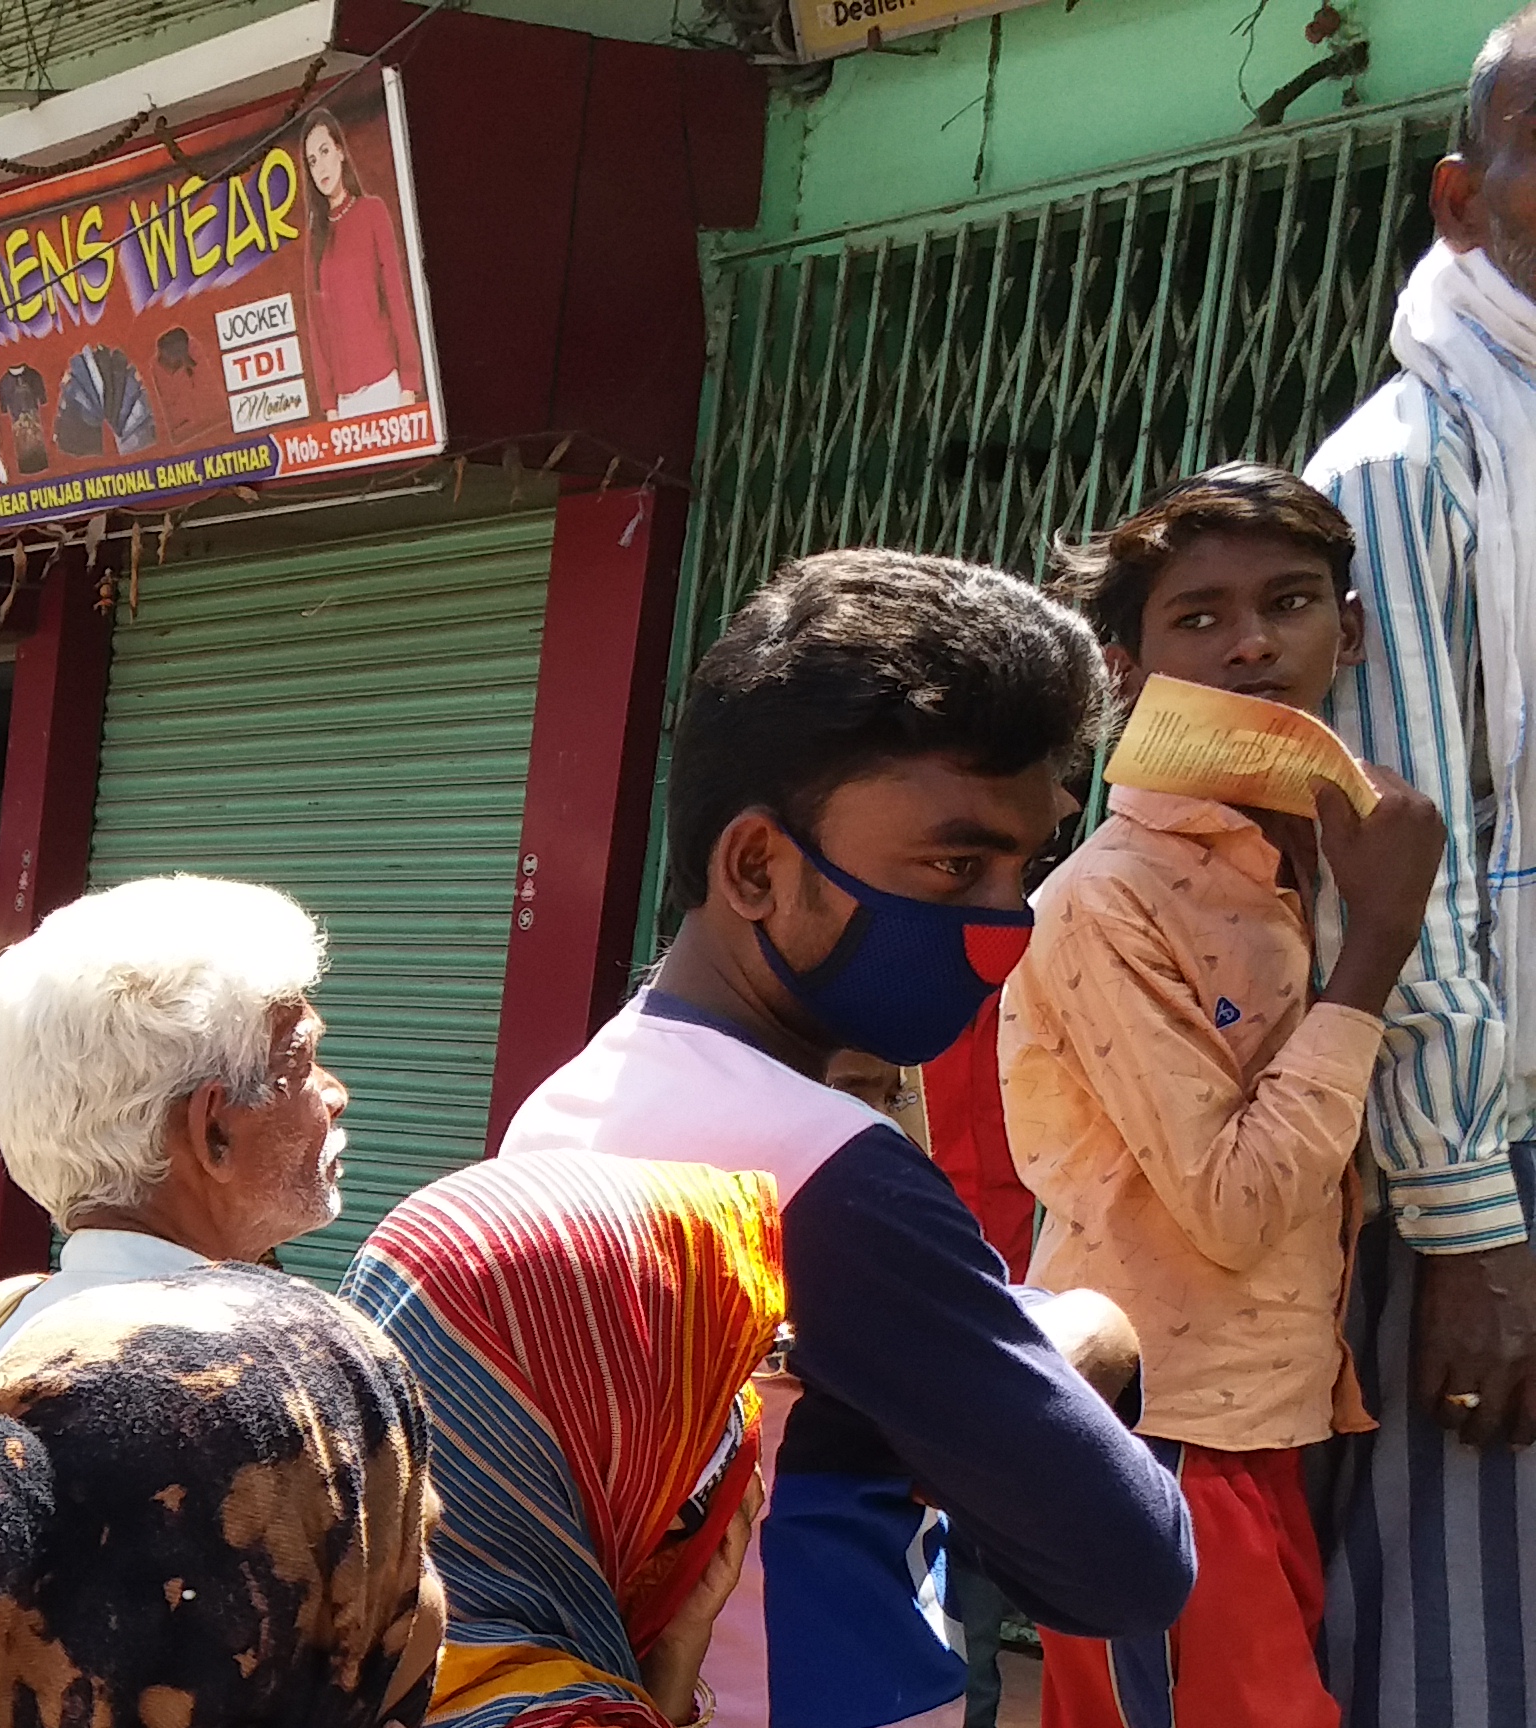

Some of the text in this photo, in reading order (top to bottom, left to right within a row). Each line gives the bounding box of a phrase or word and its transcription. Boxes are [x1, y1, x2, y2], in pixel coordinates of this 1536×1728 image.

[129, 147, 300, 291] WEAR
[222, 302, 288, 341] JOCKEY
[232, 347, 285, 381] TDI
[330, 409, 428, 455] 9934439877
[30, 480, 83, 511] PUNJAB
[84, 469, 155, 499] NATIONAL
[156, 460, 203, 487] BANK,
[203, 444, 272, 480] KATIHAR
